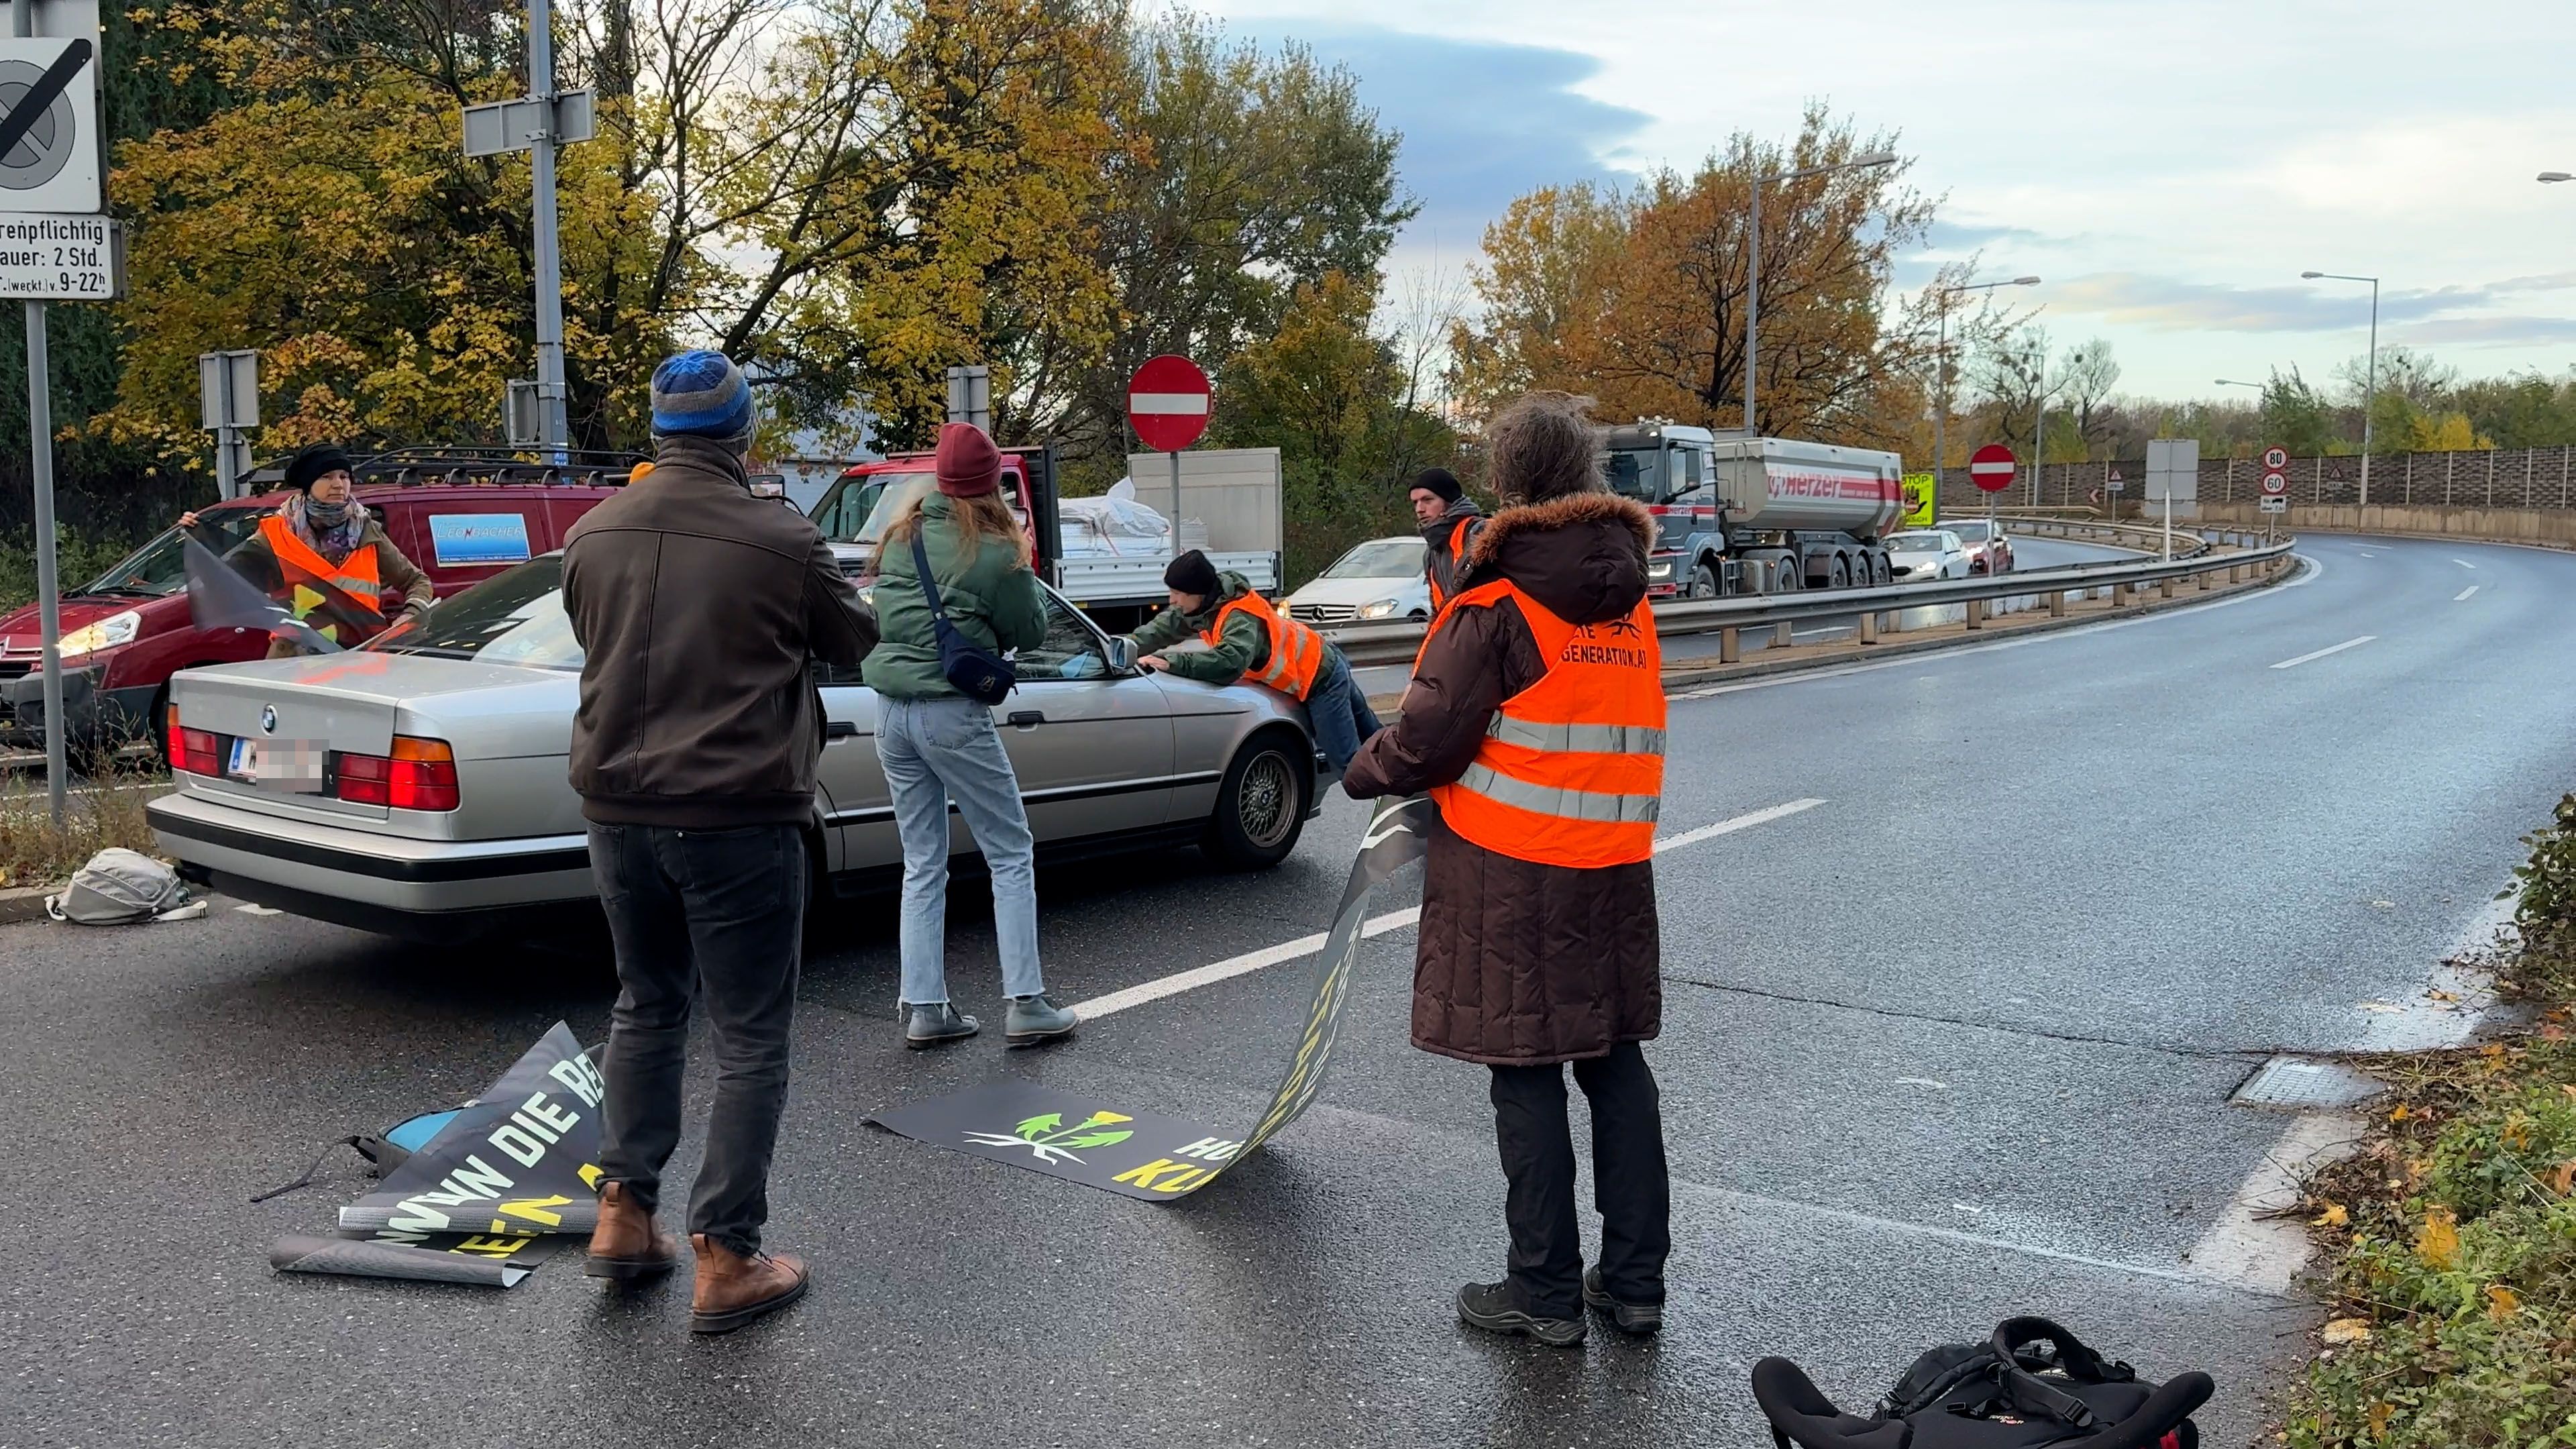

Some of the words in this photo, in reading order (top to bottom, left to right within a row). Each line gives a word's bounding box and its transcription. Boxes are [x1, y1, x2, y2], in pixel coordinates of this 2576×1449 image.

[54, 247, 63, 266] 2
[69, 247, 102, 266] Std.
[2270, 453, 2282, 464] 80
[1784, 472, 1839, 498] Herzer
[2267, 478, 2281, 488] 60
[488, 1091, 581, 1169] DIE
